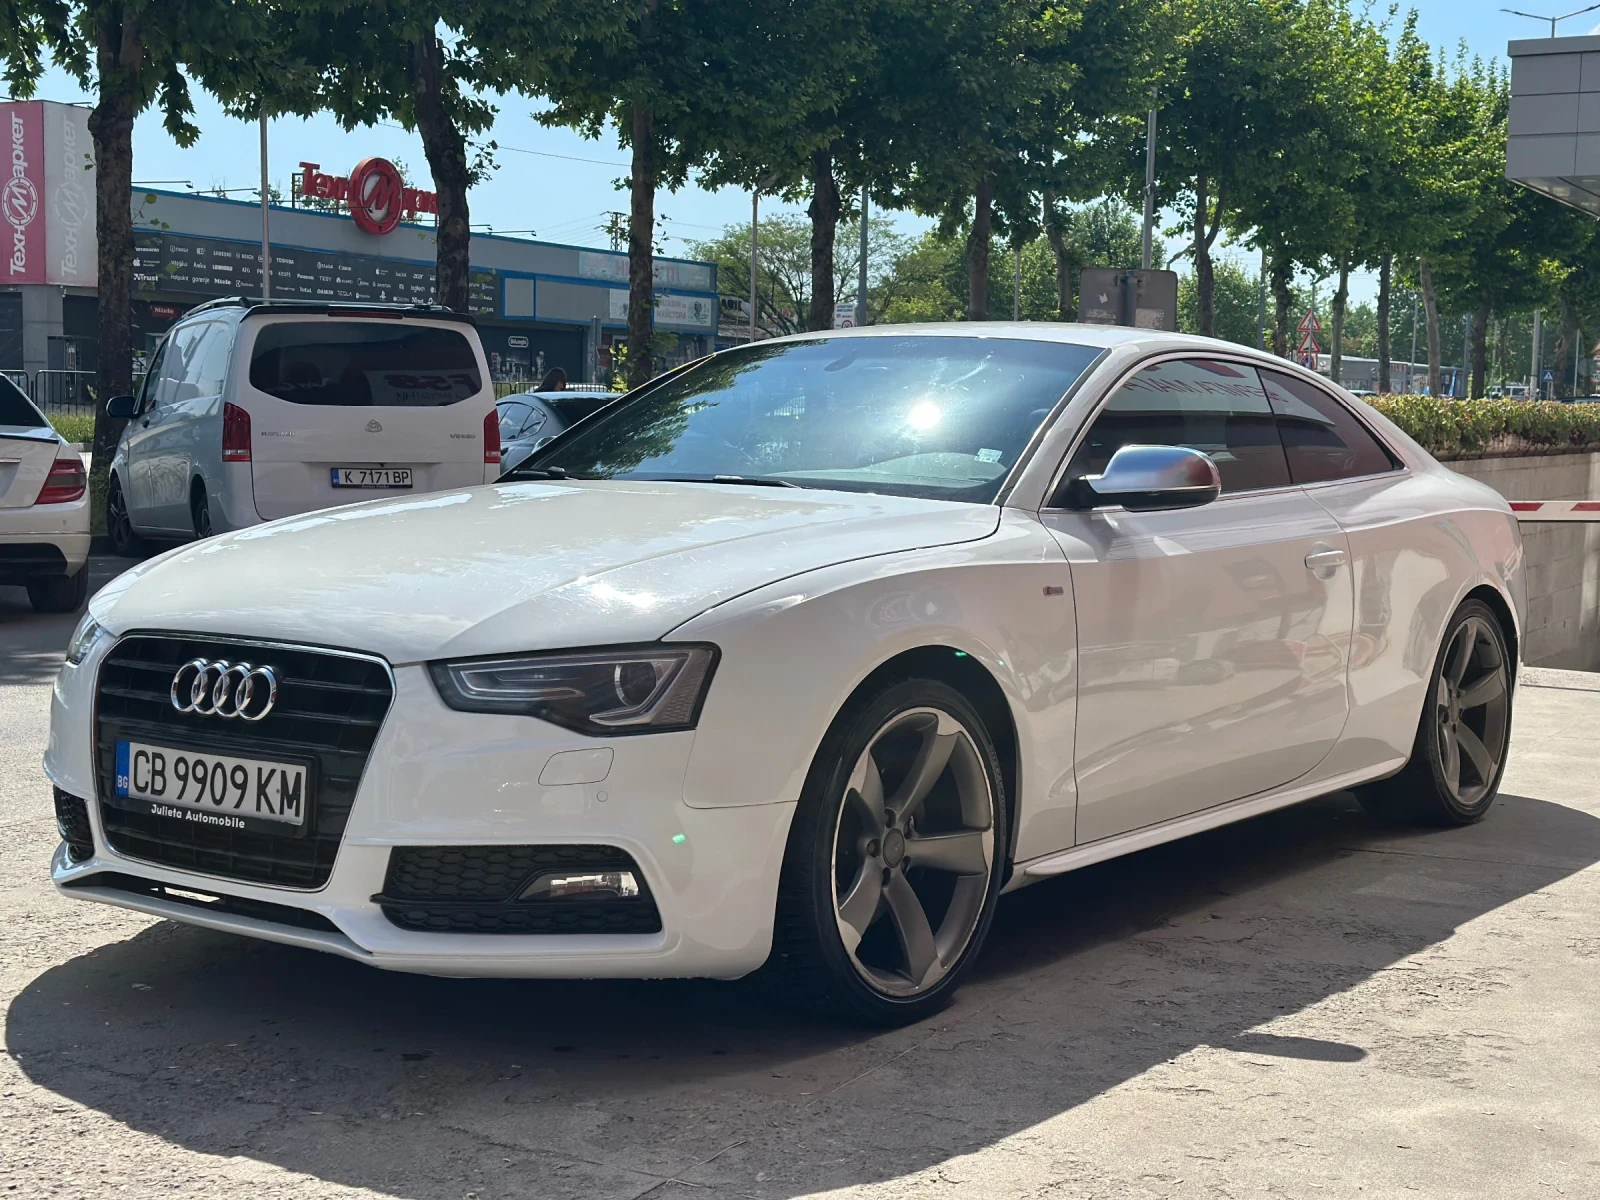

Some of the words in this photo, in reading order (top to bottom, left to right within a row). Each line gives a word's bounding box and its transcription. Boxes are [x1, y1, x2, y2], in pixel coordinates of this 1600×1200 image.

[359, 471, 390, 484] 7171
[117, 775, 128, 788] BG
[173, 756, 249, 809] 9909
[151, 803, 182, 819] Julieta
[185, 810, 246, 829] Automobile
